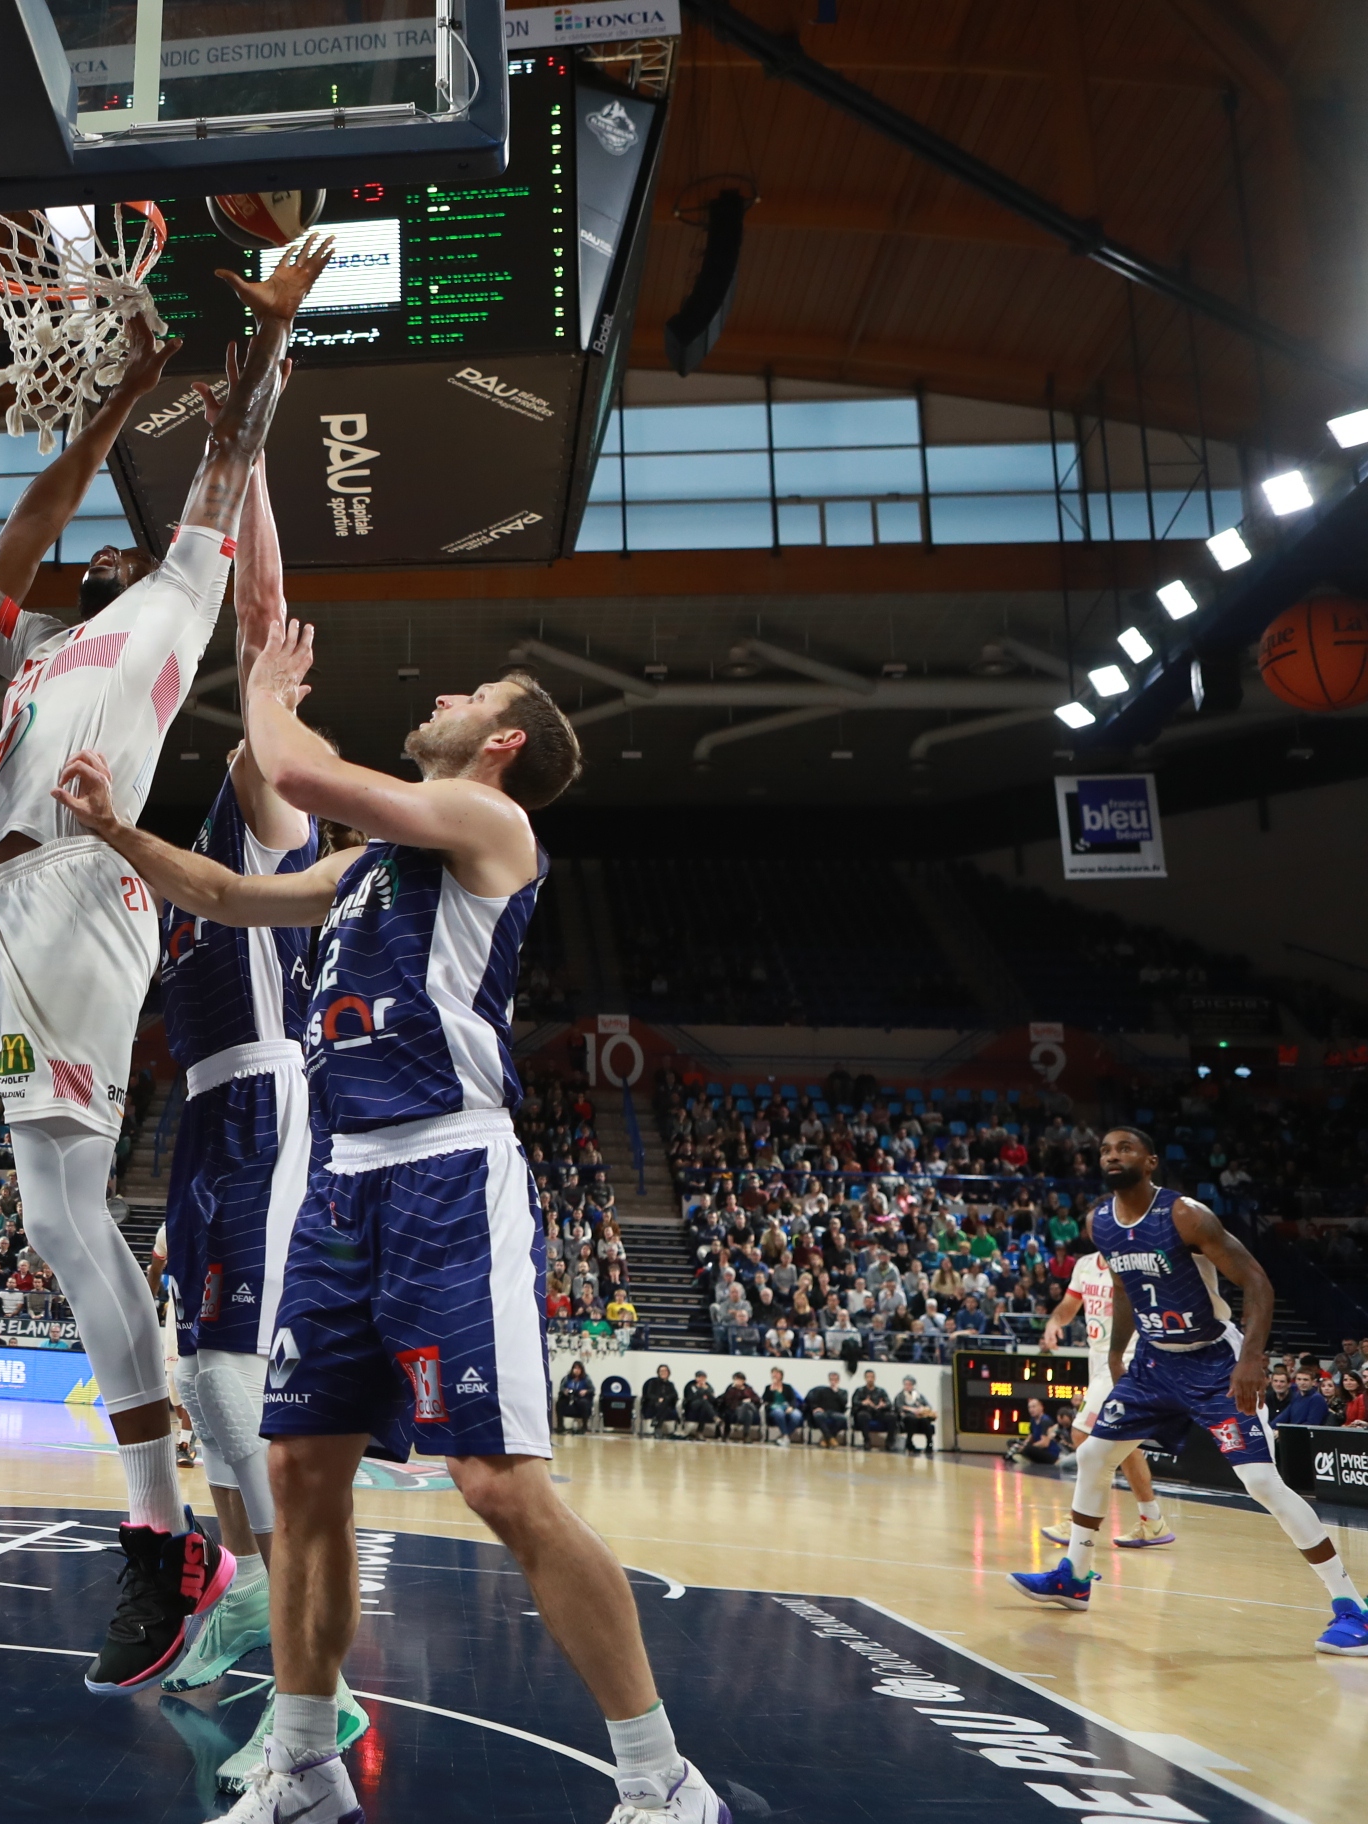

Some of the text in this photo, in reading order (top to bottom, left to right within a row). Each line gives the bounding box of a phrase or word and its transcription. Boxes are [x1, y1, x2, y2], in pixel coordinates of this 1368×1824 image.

[585, 10, 664, 28] FONCIA
[206, 41, 287, 64] GESTION
[292, 27, 387, 56] LOCATION
[593, 314, 615, 354] Bodet
[455, 366, 520, 398] PAU
[134, 402, 188, 435] PAU
[319, 413, 381, 494] PAU
[326, 497, 353, 537] sportive
[348, 496, 374, 536] Capitale
[489, 512, 544, 539] PAU
[1082, 804, 1149, 831] bleu
[1109, 799, 1146, 810] france
[1116, 830, 1150, 840] béarn
[120, 876, 148, 912] 21
[582, 1032, 644, 1088] 10
[1029, 1042, 1067, 1084] 9
[1109, 1252, 1160, 1273] BEARNAIS
[231, 1294, 257, 1304] PEAK
[1087, 1299, 1103, 1317] 32
[1142, 1283, 1158, 1308] 7
[455, 1382, 489, 1395] PEAK
[913, 1706, 1136, 1780] PAU
